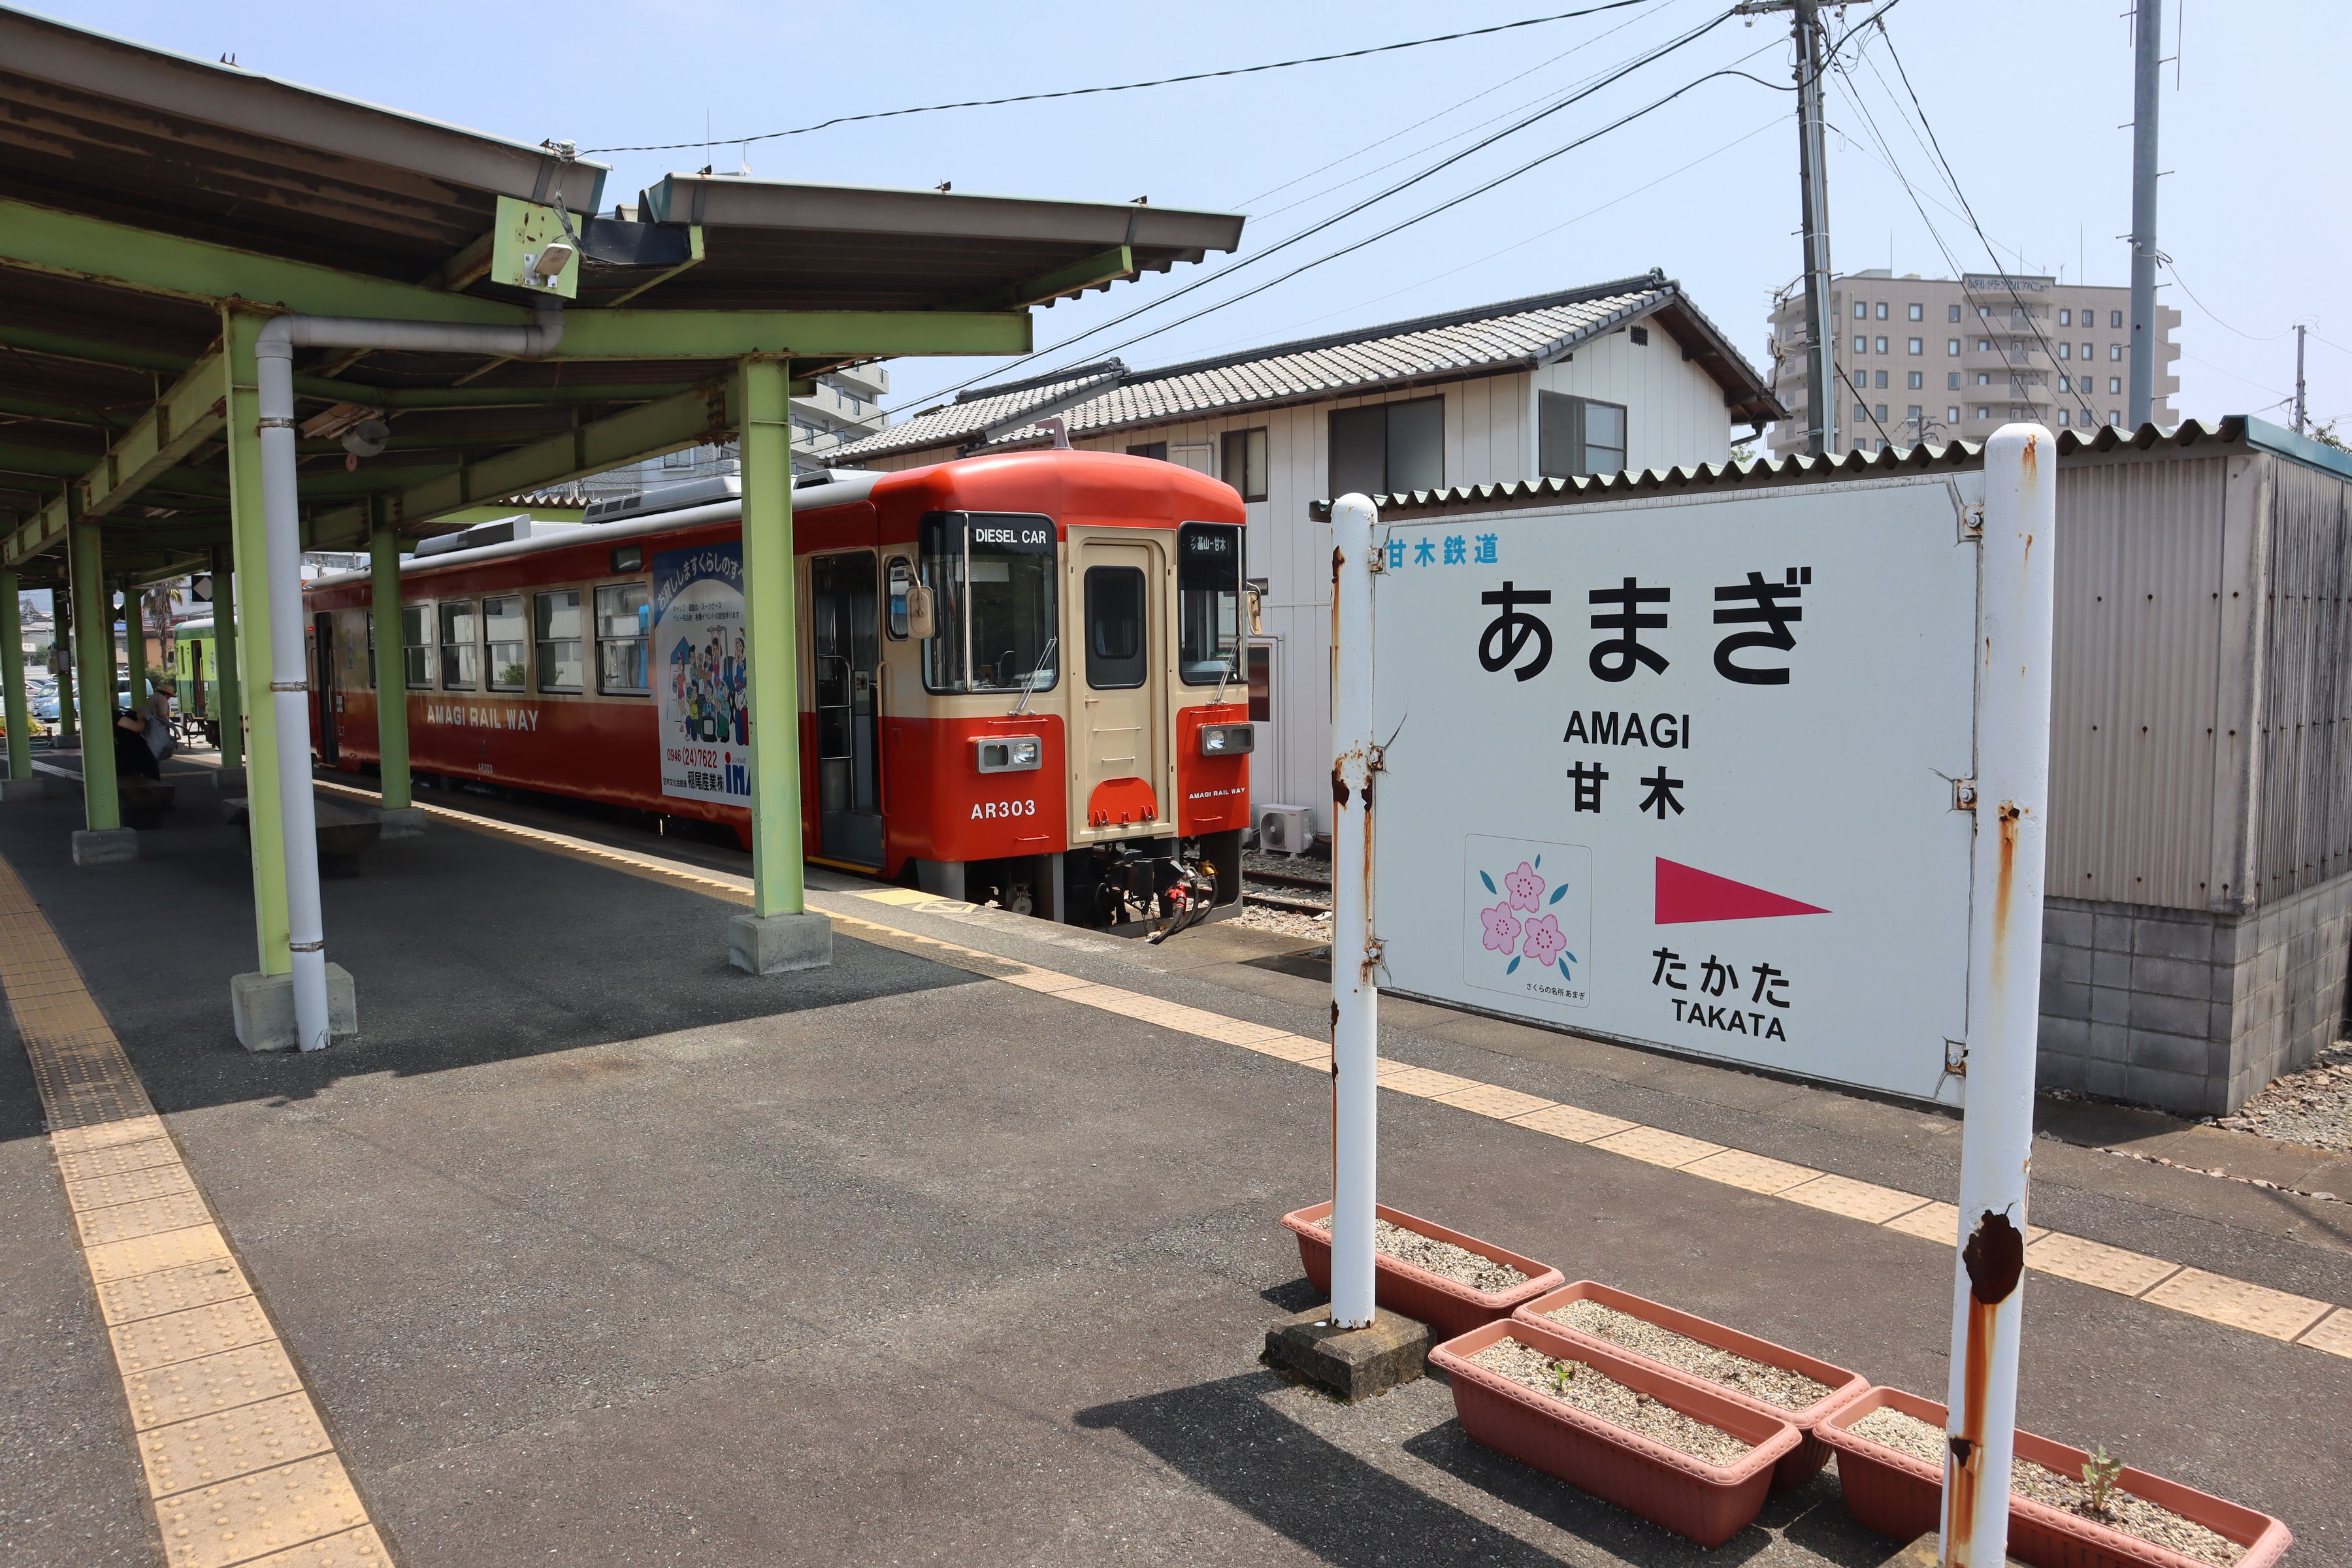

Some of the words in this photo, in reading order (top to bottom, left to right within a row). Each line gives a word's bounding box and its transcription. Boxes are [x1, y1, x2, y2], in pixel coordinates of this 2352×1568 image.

[975, 529, 1017, 543] DIESEL
[1021, 530, 1047, 544] CAR
[1386, 532, 1498, 568] 甘木鉄道
[1478, 566, 1812, 685] あまぎ
[427, 705, 466, 726] AMAGI
[470, 707, 502, 729] RAIL
[506, 709, 538, 732] WAY
[1563, 710, 1690, 749] AMAGI
[478, 762, 493, 774] AR303
[1188, 791, 1211, 800] AMAGI
[1567, 760, 1685, 820] 甘木
[970, 799, 1036, 820] AR303
[1526, 983, 1564, 997] さくらの名所
[1565, 989, 1586, 1000] あまぎ
[1652, 947, 1790, 1009] たかた
[1671, 998, 1787, 1042] TAKATA
